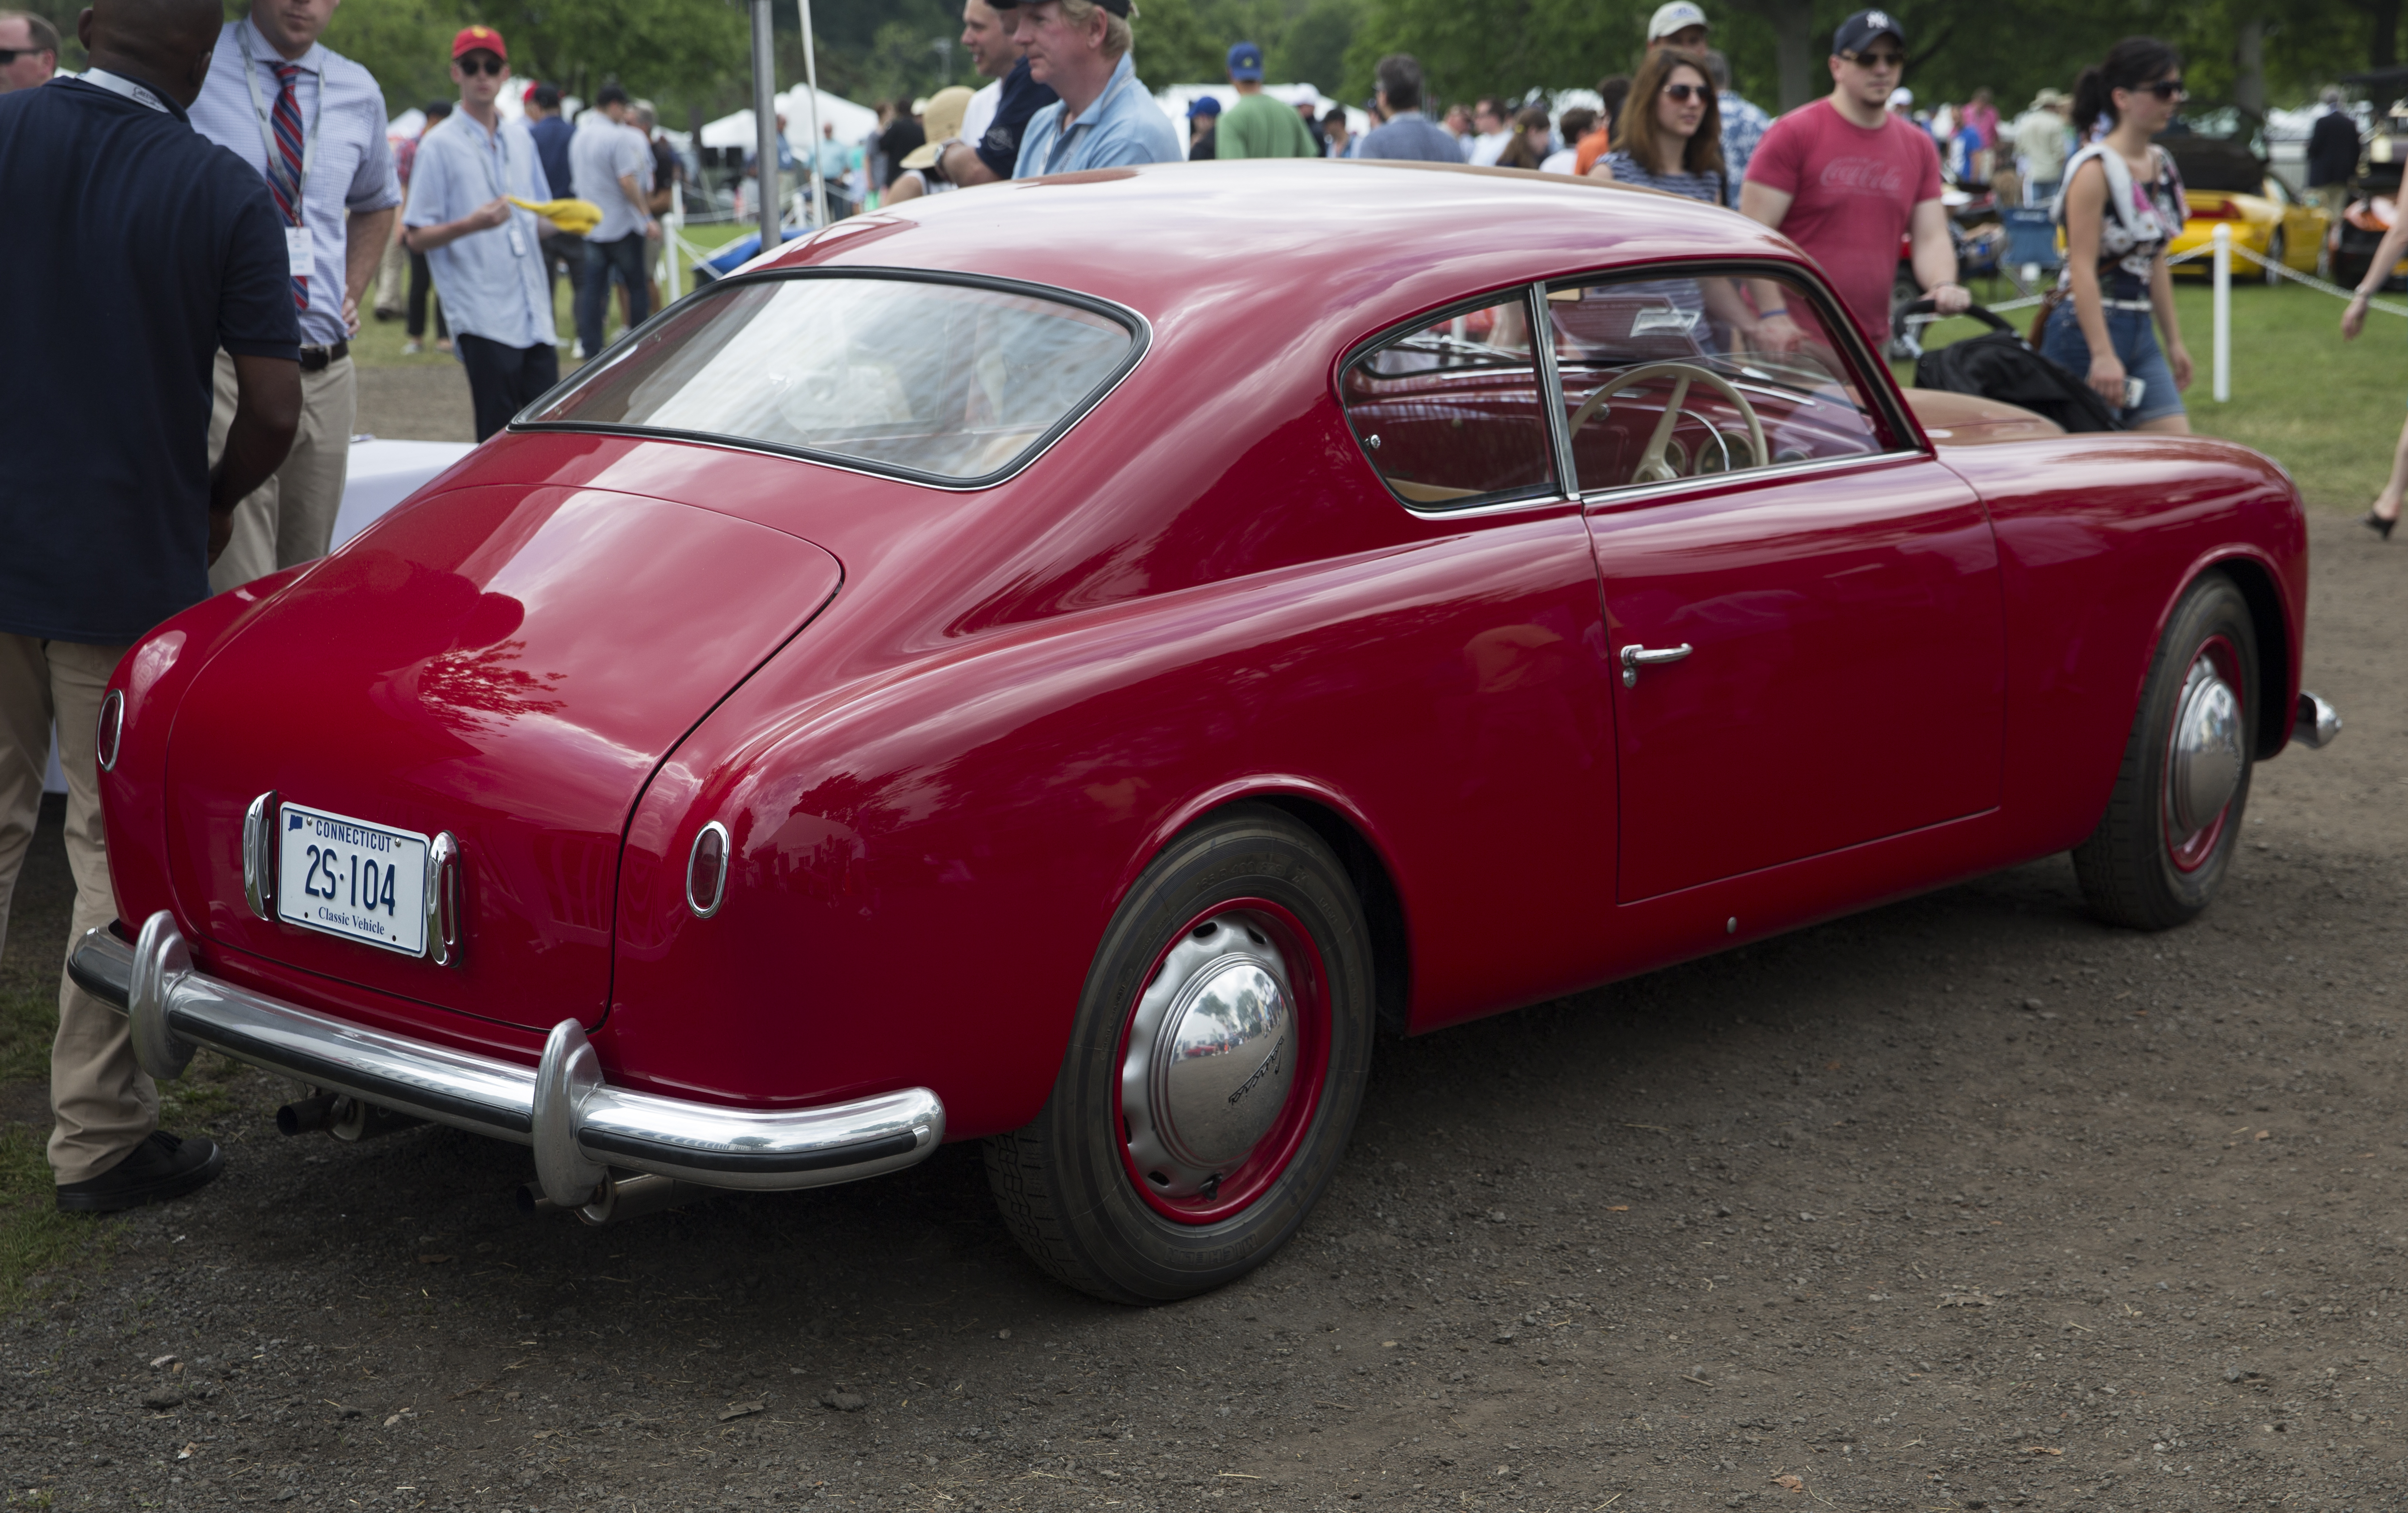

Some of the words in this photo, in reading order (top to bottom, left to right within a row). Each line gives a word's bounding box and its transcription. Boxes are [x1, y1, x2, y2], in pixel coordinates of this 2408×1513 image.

[316, 819, 391, 853] CONNECTICUT
[318, 906, 349, 926] Classic
[352, 915, 385, 935] Vehicle
[1228, 1035, 1284, 1106] Lancia
[1164, 1233, 1258, 1265] MICHELIN
